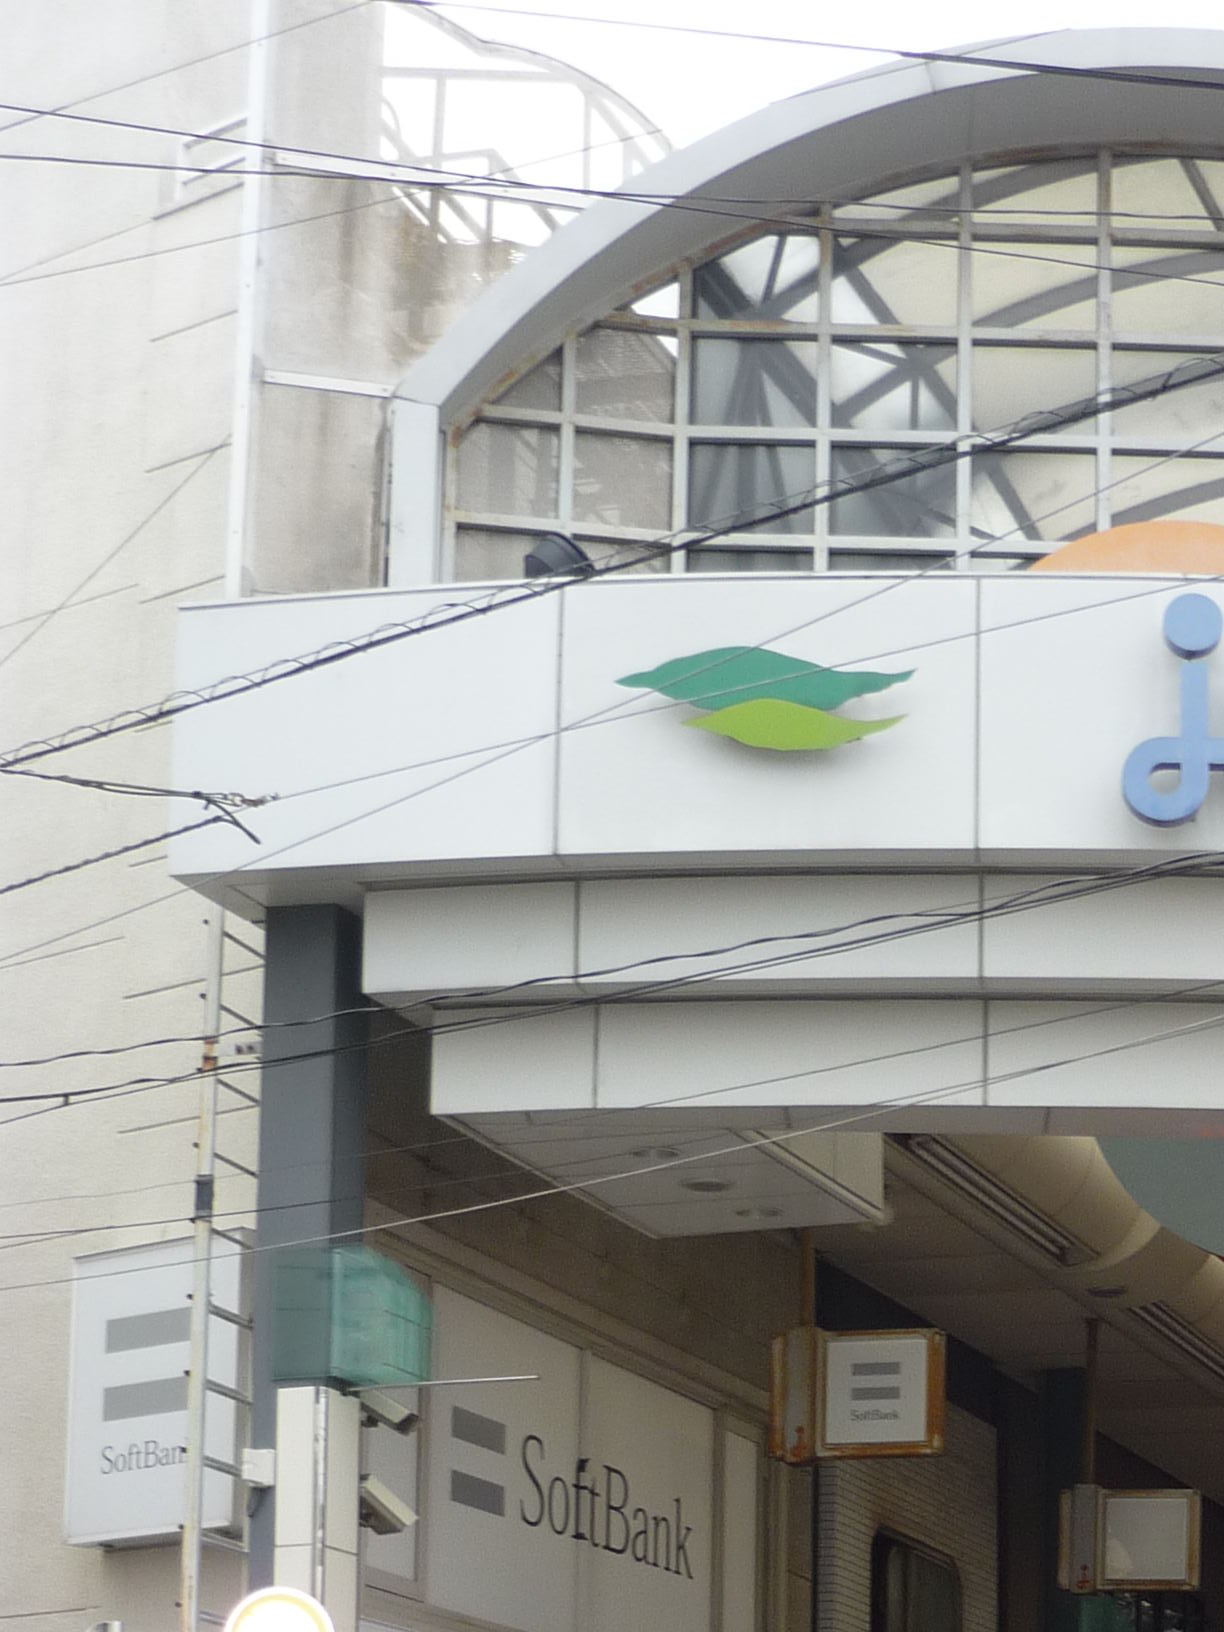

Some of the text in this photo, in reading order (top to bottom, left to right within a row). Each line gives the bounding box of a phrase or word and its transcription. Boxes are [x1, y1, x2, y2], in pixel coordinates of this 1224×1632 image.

[849, 1409, 900, 1422] SoftBank
[101, 1439, 200, 1475] SoftBan
[520, 1435, 695, 1581] SoftBank
